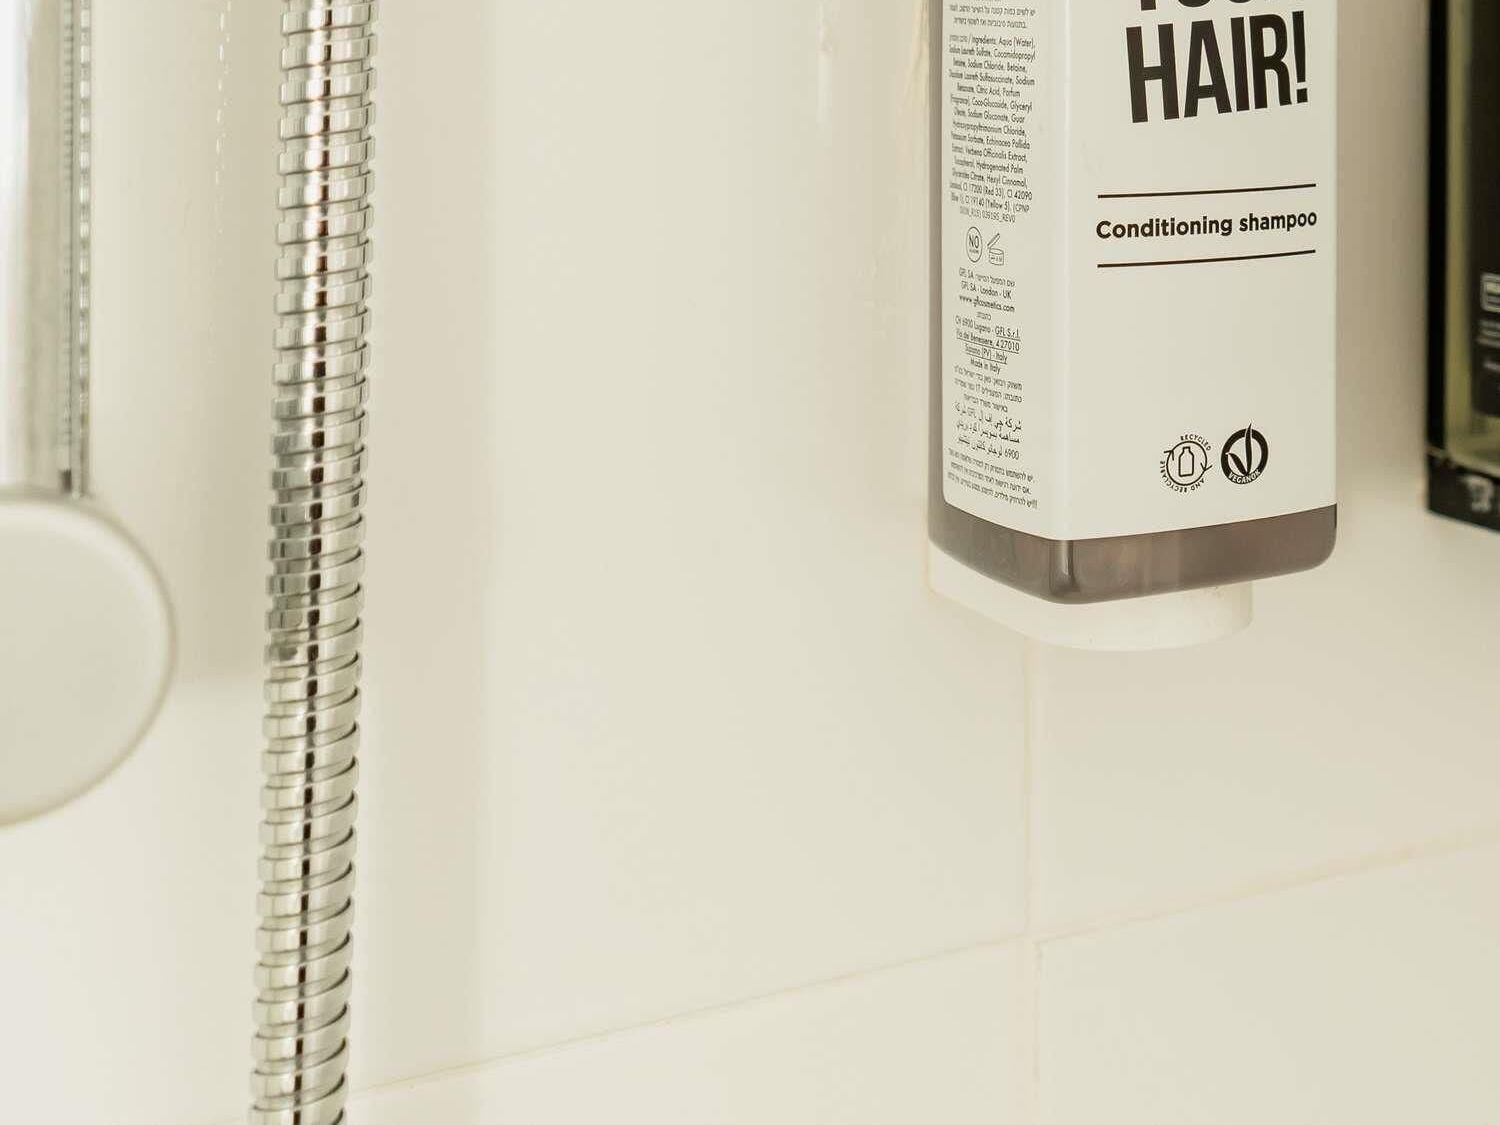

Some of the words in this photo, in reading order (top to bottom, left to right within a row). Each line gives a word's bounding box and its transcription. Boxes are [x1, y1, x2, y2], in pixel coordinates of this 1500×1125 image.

[1125, 10, 1309, 124] HAIR!
[1096, 215, 1233, 239] Conditioning
[1239, 211, 1317, 232] shampoo
[1180, 433, 1212, 452] RECYCLED
[1190, 477, 1205, 492] AND
